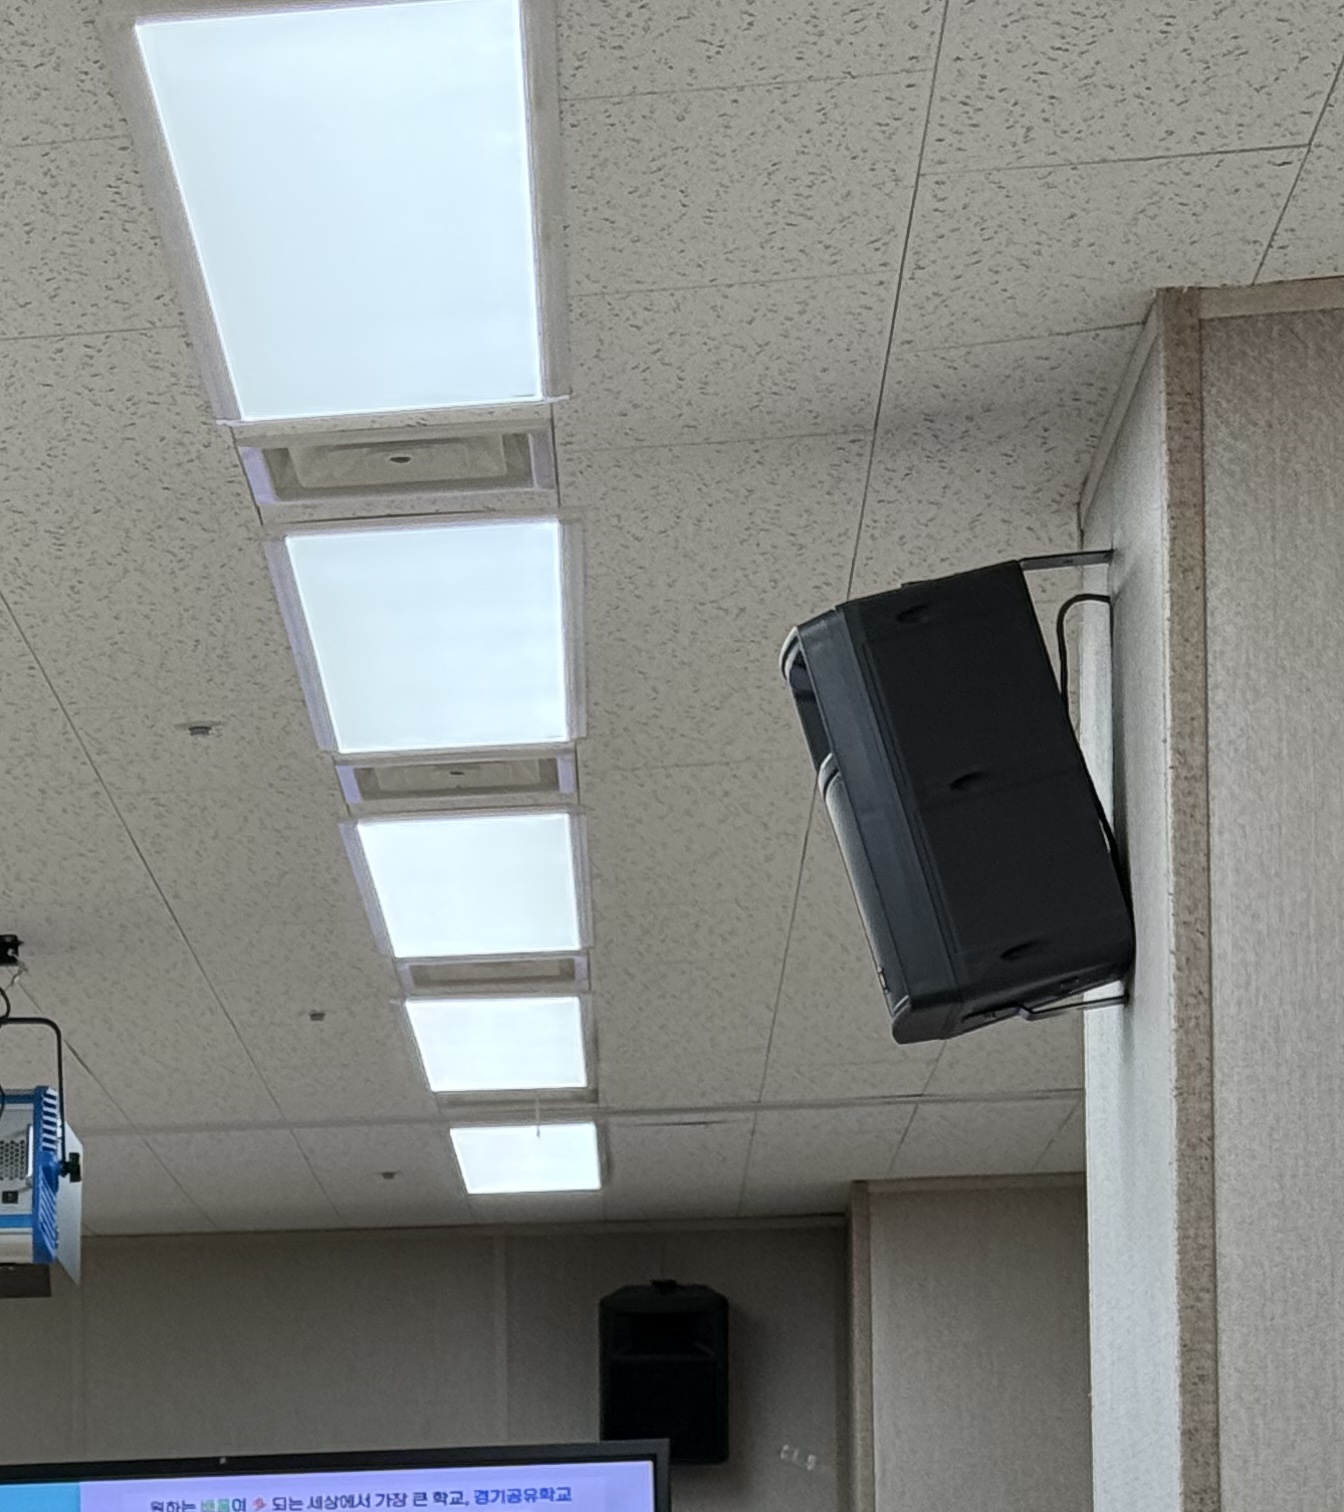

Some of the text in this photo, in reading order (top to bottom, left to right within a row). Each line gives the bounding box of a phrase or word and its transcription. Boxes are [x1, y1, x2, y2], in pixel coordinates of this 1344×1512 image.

[272, 1496, 303, 1512] 되는
[306, 1493, 371, 1511] 세상에서
[375, 1492, 408, 1508] 가장
[412, 1491, 428, 1507] 큰
[473, 1486, 573, 1505] 경기공유학교
